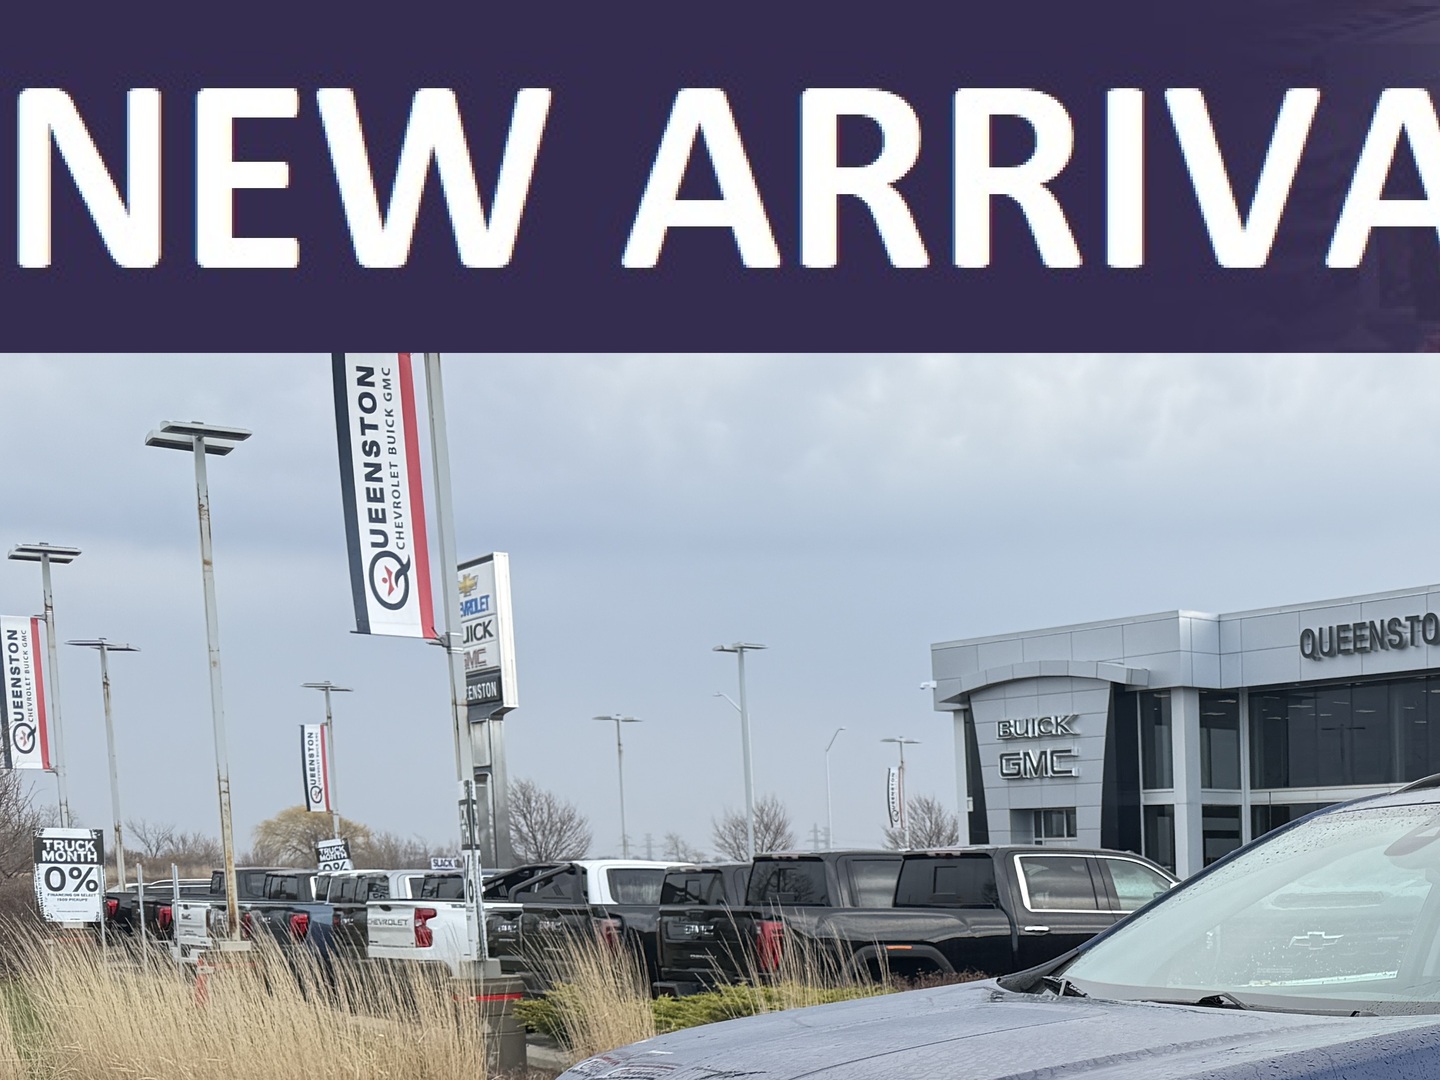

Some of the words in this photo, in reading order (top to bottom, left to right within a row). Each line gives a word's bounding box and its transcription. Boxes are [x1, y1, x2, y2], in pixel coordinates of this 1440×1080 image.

[381, 367, 393, 402] GMC
[384, 408, 398, 455] BUICK
[355, 365, 411, 611] QUEENSTON
[389, 461, 406, 550] CHEVROLET
[460, 594, 490, 618] VROLET
[462, 619, 494, 644] UICK
[6, 629, 37, 755] QUEENSTON
[25, 678, 34, 722] CHEVROLET
[466, 680, 498, 701] ENSTON
[997, 714, 1080, 740] BUICK
[307, 732, 323, 804] QUEENSTON
[999, 746, 1080, 779] GMC
[42, 839, 96, 852] TRUCK
[42, 850, 98, 863] MONTH
[44, 866, 99, 892] 0%
